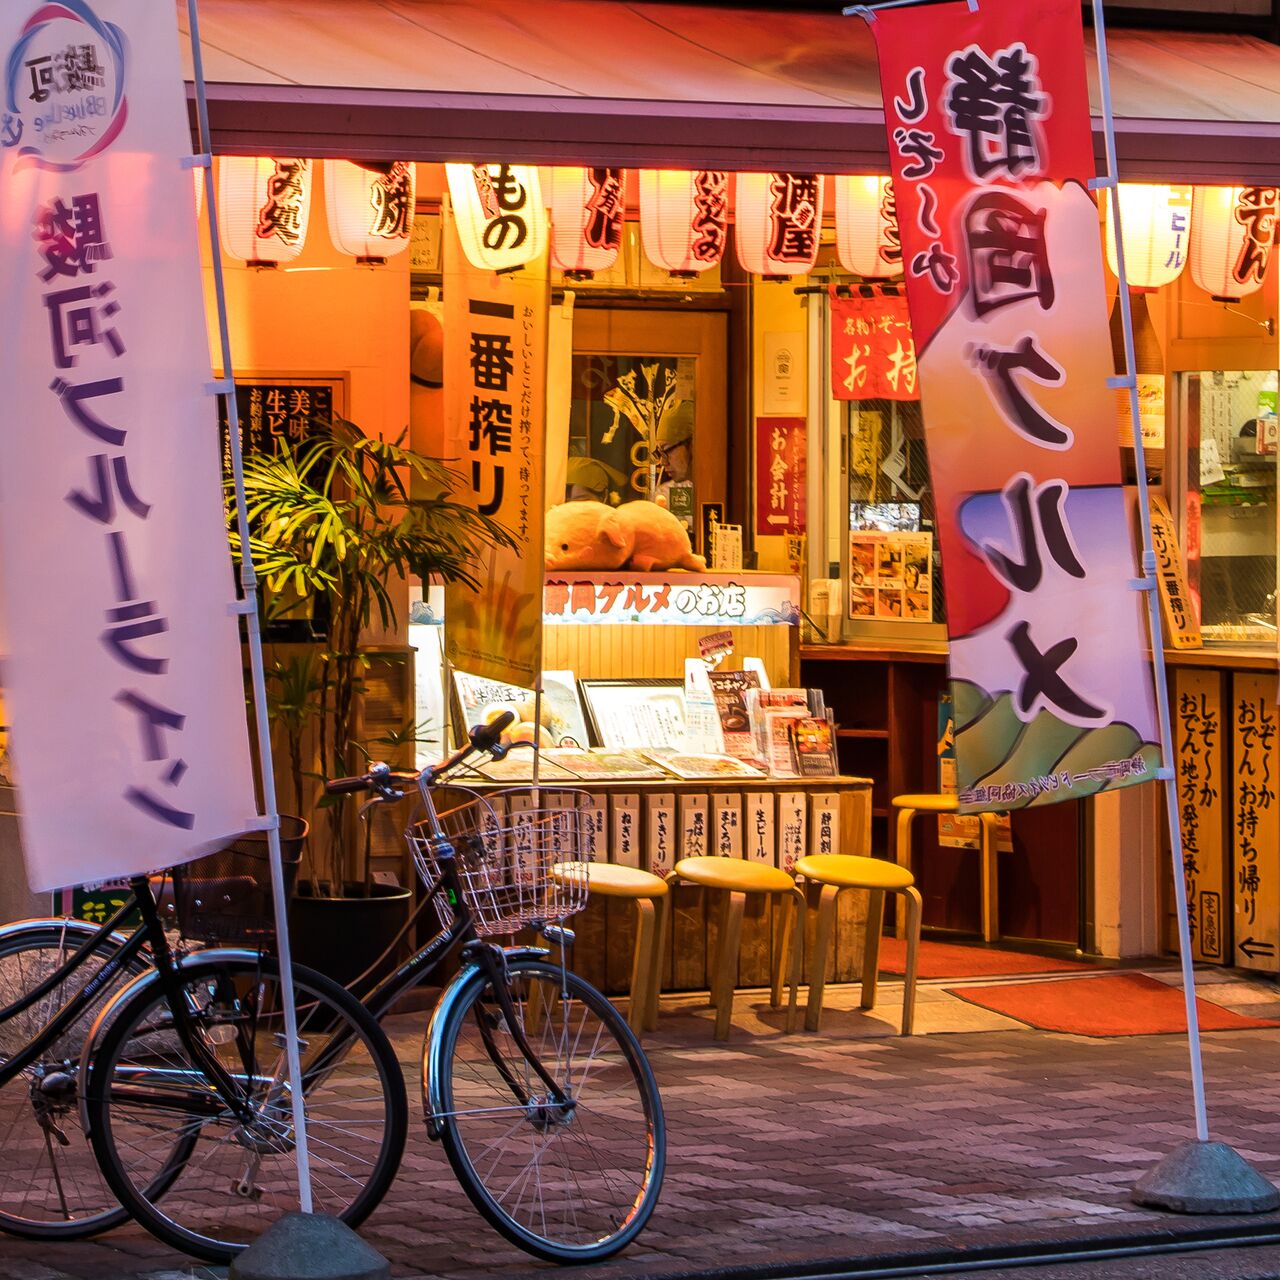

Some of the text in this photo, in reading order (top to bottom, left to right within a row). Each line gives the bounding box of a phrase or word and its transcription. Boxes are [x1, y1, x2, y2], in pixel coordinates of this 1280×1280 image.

[468, 298, 515, 517] 一番搾り
[769, 426, 789, 511] お会計
[544, 581, 747, 617] 静岡グルメのお店
[1152, 523, 1187, 631] キリン一番搾り
[1180, 692, 1201, 756] おでん
[621, 811, 632, 853] ねぎま
[657, 810, 668, 863] やきとり
[756, 809, 768, 858] 生ビール
[1237, 698, 1261, 926] おでん お持ち帰り
